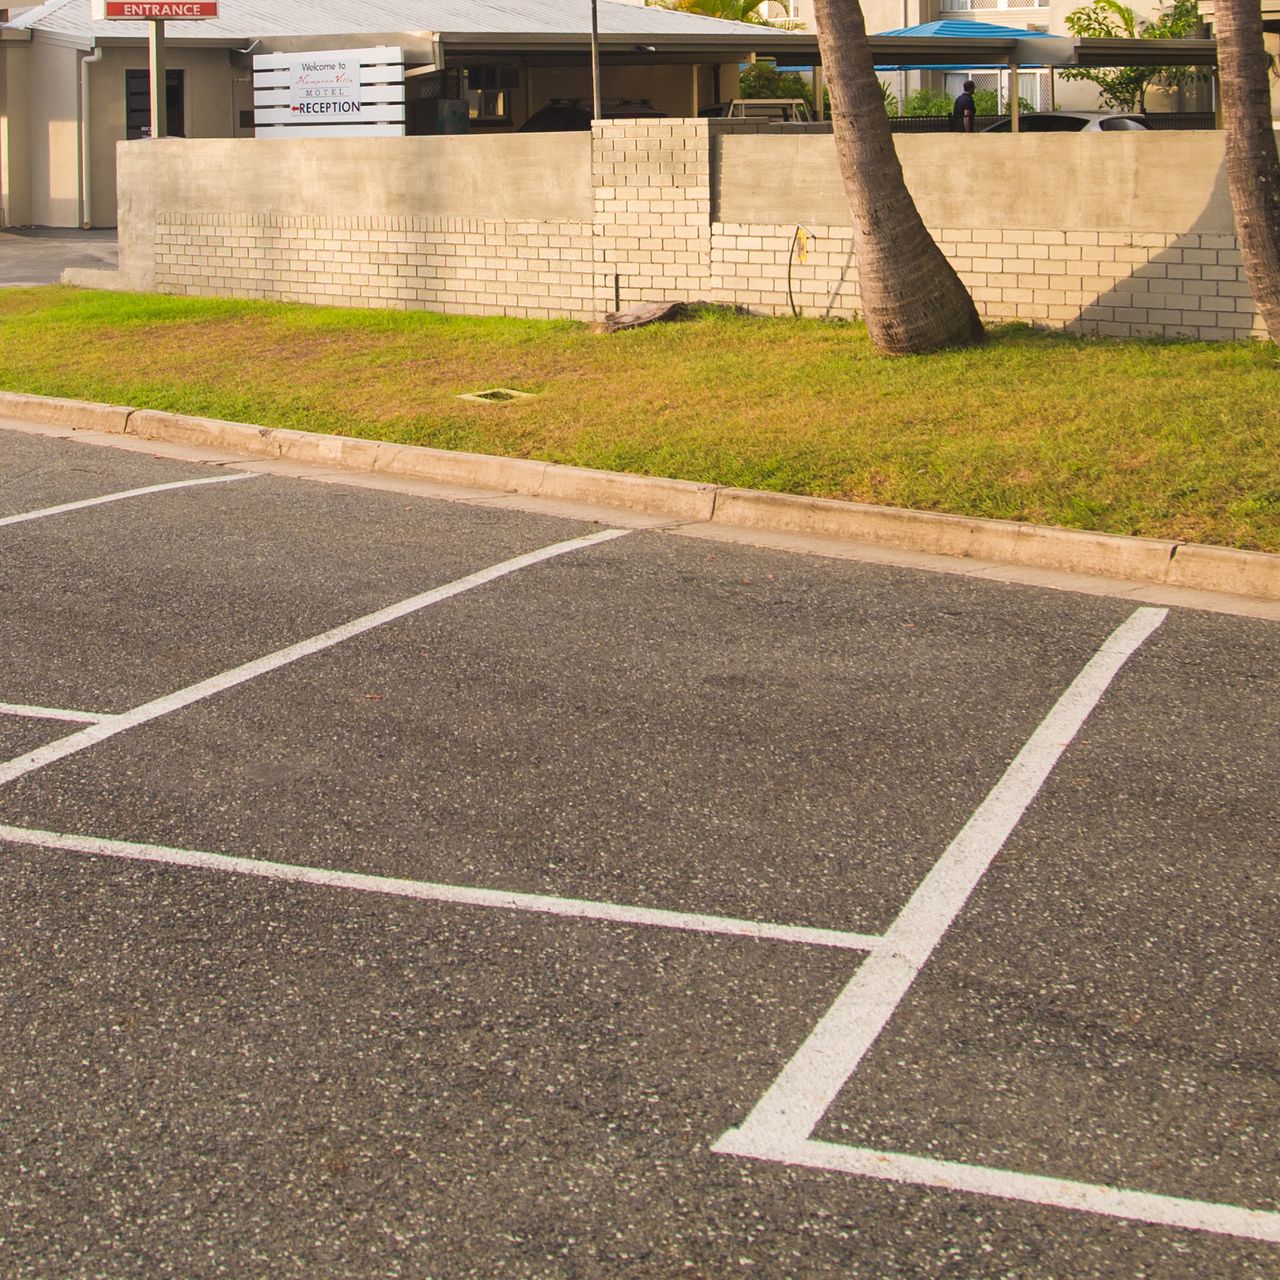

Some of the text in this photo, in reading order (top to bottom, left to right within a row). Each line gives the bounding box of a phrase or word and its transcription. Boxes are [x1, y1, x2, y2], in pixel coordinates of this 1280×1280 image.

[124, 4, 201, 16] ENTRANCE
[302, 62, 346, 72] Welcome to
[305, 88, 344, 96] MOTEL
[299, 101, 360, 113] RECEPTION
